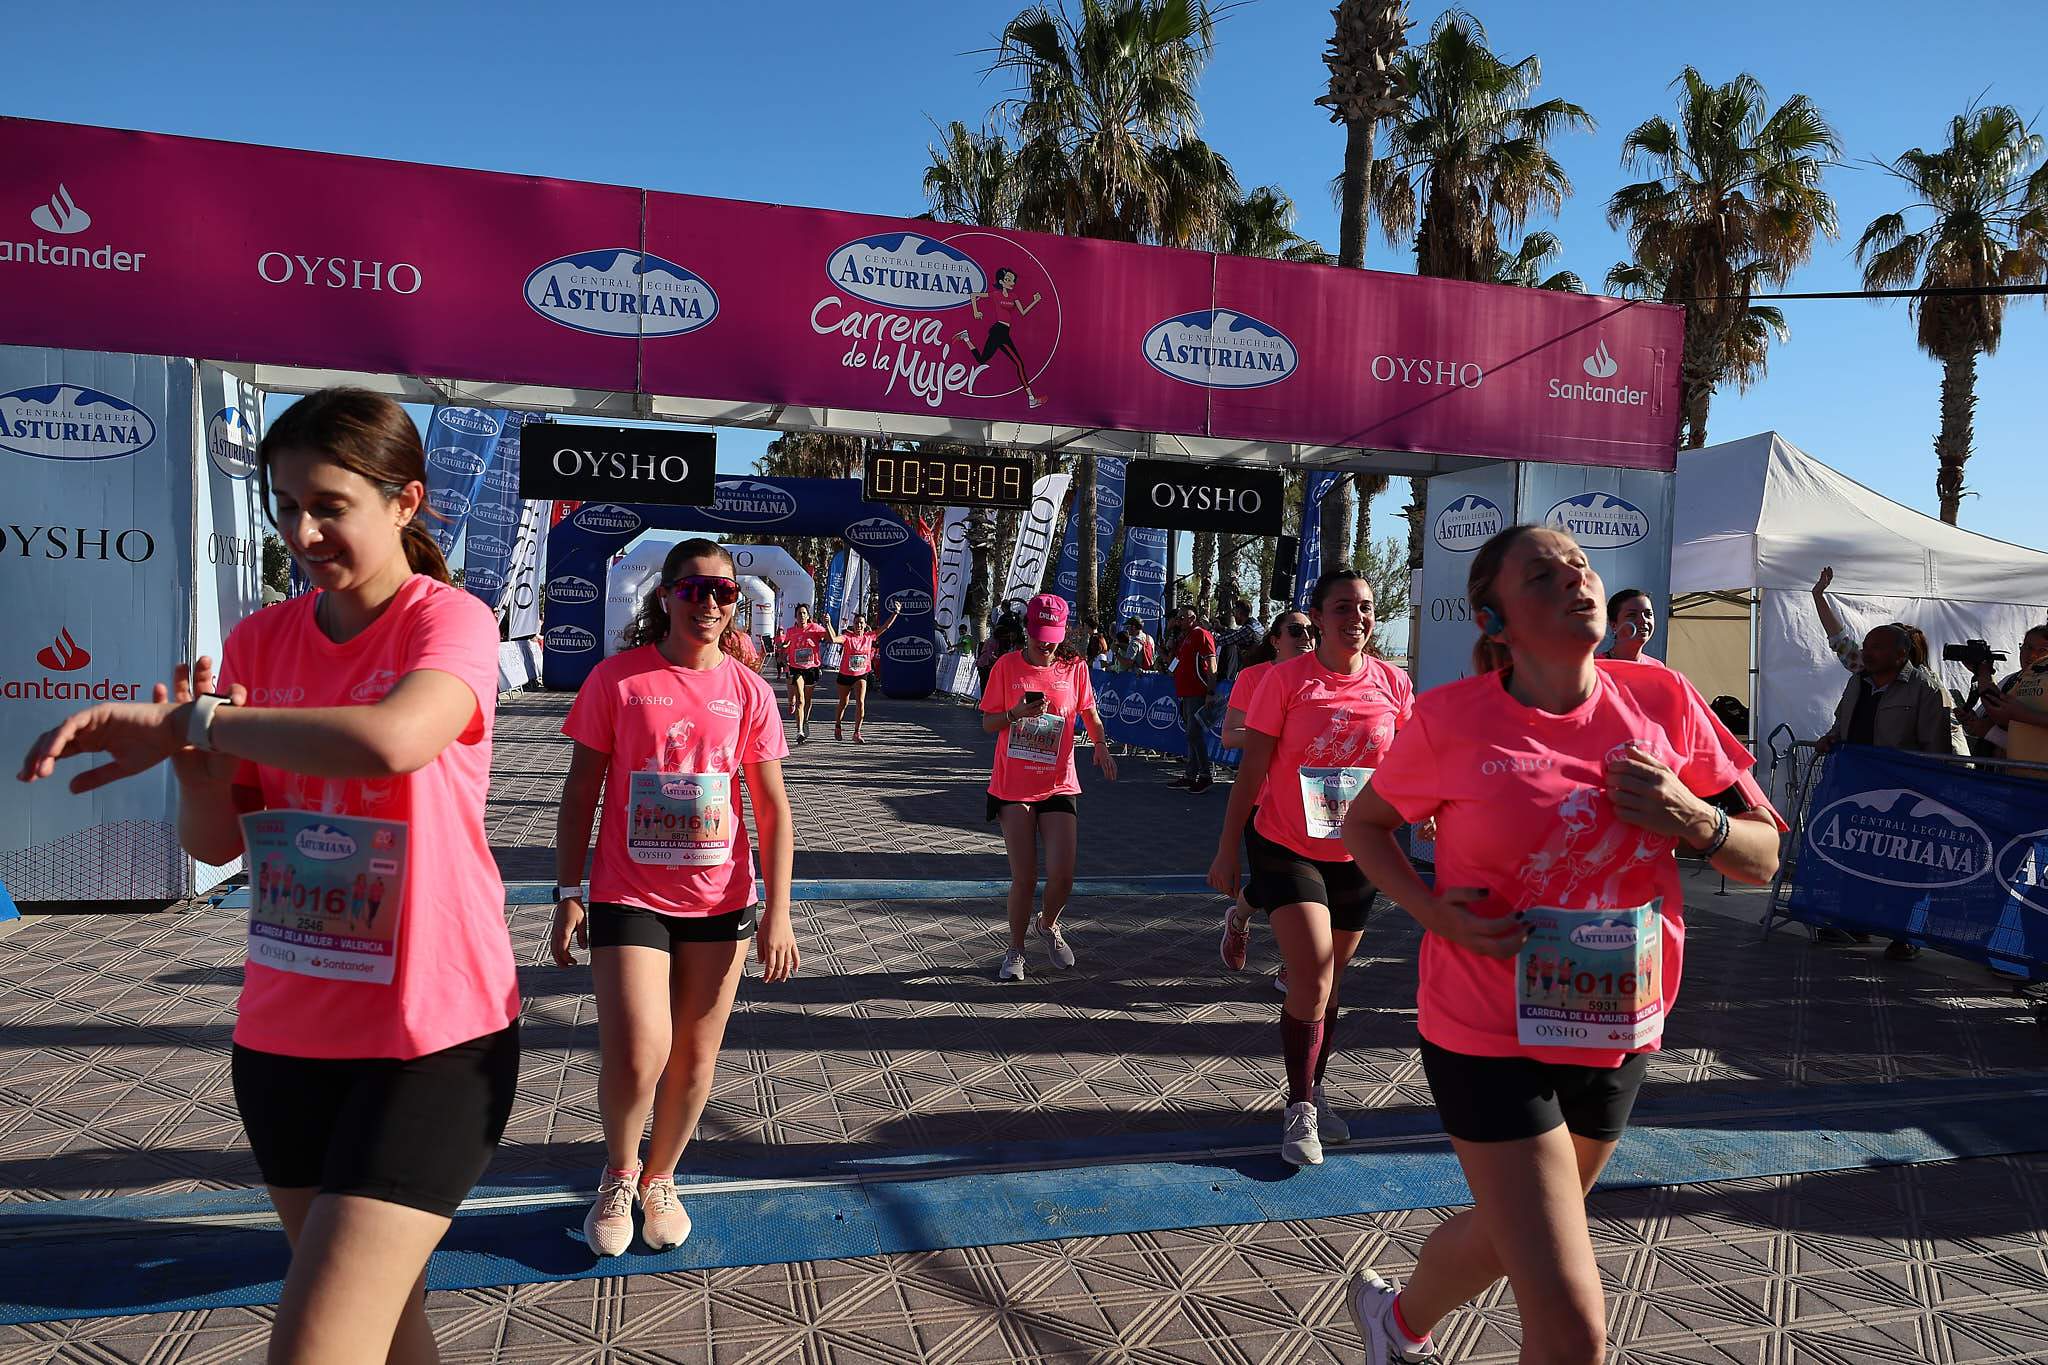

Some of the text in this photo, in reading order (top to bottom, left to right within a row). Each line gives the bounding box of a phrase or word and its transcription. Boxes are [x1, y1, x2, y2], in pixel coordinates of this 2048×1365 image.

[0, 238, 146, 272] antander
[864, 254, 971, 273] CENTRAL LECHERA
[257, 251, 422, 295] OYSHO
[570, 275, 632, 288] CENTRAL
[838, 254, 973, 296] ASTURIANA
[538, 274, 704, 320] ASTURIANA
[810, 296, 942, 346] Carrera
[1179, 332, 1282, 350] CENTRAL LECHERA
[1154, 332, 1286, 372] ASTURIANA
[842, 341, 990, 407] de la Mujer
[1370, 354, 1483, 389] OYSHO
[1548, 377, 1648, 407] Santander
[16, 407, 137, 423] CENTRAL LECHERA
[442, 412, 494, 434] ASTURIANA
[432, 451, 482, 473] ASTURIANA
[552, 448, 689, 483] OYSHO
[875, 458, 1022, 501] 00:39:09
[705, 498, 788, 515] STURIANA
[1150, 481, 1262, 514] OYSHO
[576, 512, 637, 530] ASTURIANA
[1554, 511, 1641, 538] ASTURIANA
[1568, 511, 1639, 521] CENTRAL LECHERA
[850, 527, 905, 541] ASTURIANA
[1437, 519, 1497, 540] ASTURIANA
[0, 524, 155, 563] YSHO
[208, 532, 256, 568] OYSHO
[549, 583, 596, 598] ASTURIANA
[546, 633, 593, 648] ASTURIANA
[628, 695, 673, 706] OYSHO
[1482, 756, 1554, 776] OYSHO
[663, 785, 702, 797] ASTURIANA
[663, 815, 700, 830] 016
[1850, 813, 1975, 845] CENTRAL LECHERA
[1817, 814, 1976, 874] ASTURIANA
[638, 850, 672, 860] OYSHO
[292, 884, 347, 914] 016
[297, 918, 324, 932] 2546
[304, 935, 333, 946] MUJER
[1574, 929, 1638, 944] ASTURIANA
[322, 958, 375, 973] Santander
[1574, 972, 1637, 995] 016
[1526, 1007, 1567, 1019] CARRERA
[1570, 1011, 1582, 1020] DE
[1584, 1012, 1596, 1021] LA
[1598, 1013, 1630, 1022] MUJER
[1588, 1000, 1618, 1011] 5931
[1535, 1024, 1588, 1039] OYSHO
